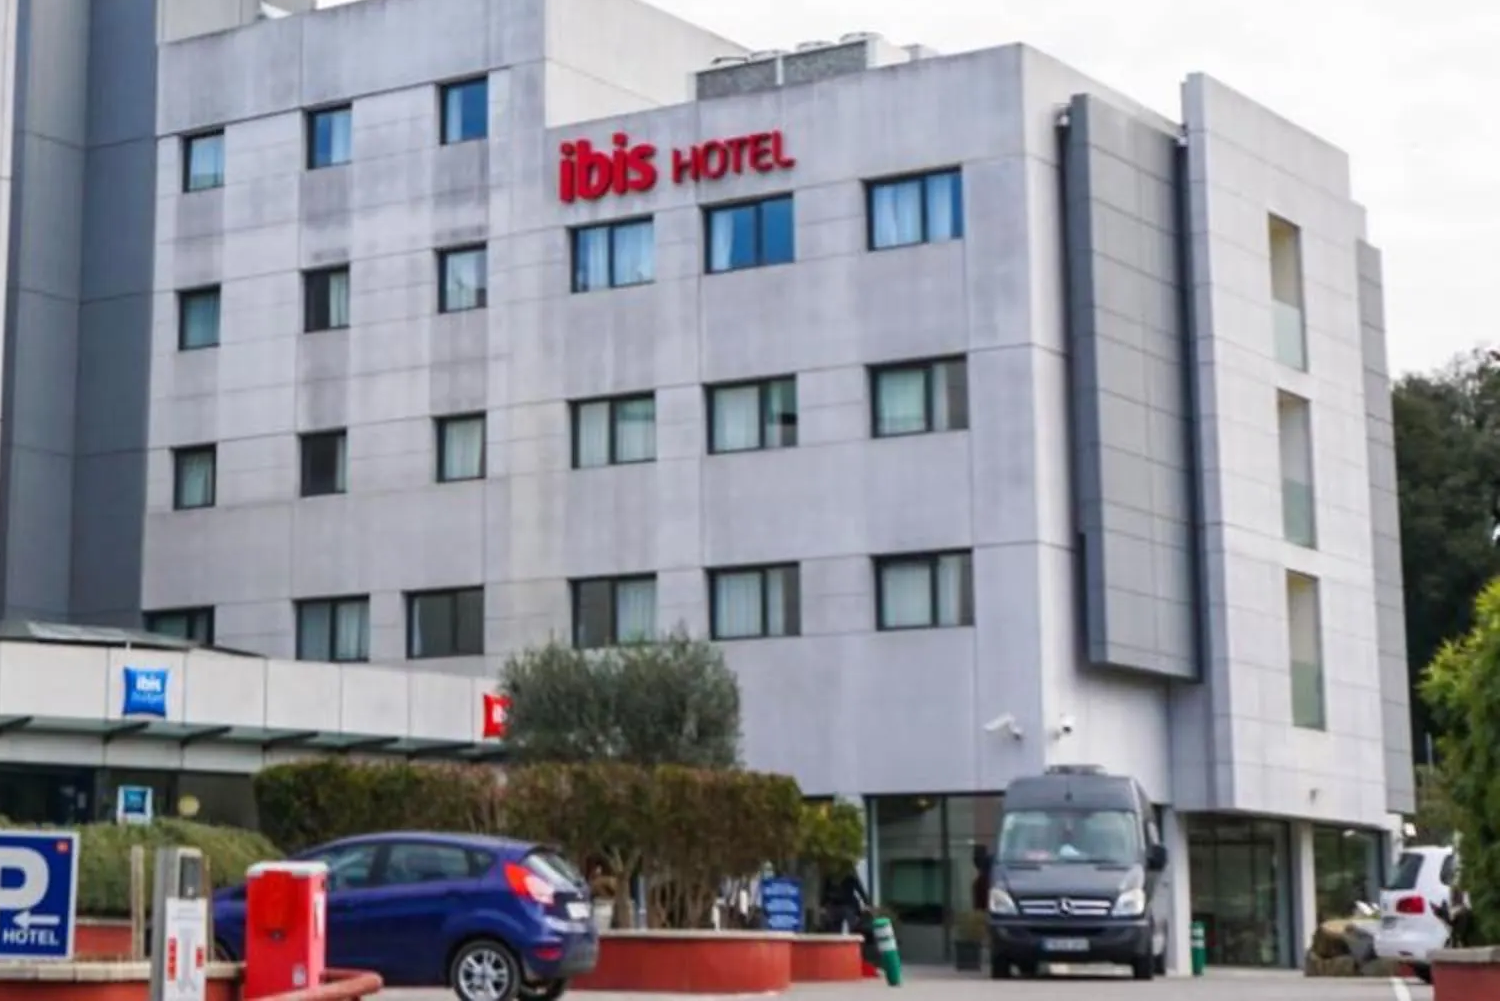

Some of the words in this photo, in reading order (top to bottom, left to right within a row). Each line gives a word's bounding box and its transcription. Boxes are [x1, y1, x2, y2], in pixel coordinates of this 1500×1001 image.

[558, 131, 659, 205] ibis
[671, 129, 797, 187] HOTEL
[2, 927, 60, 947] HOTEL
